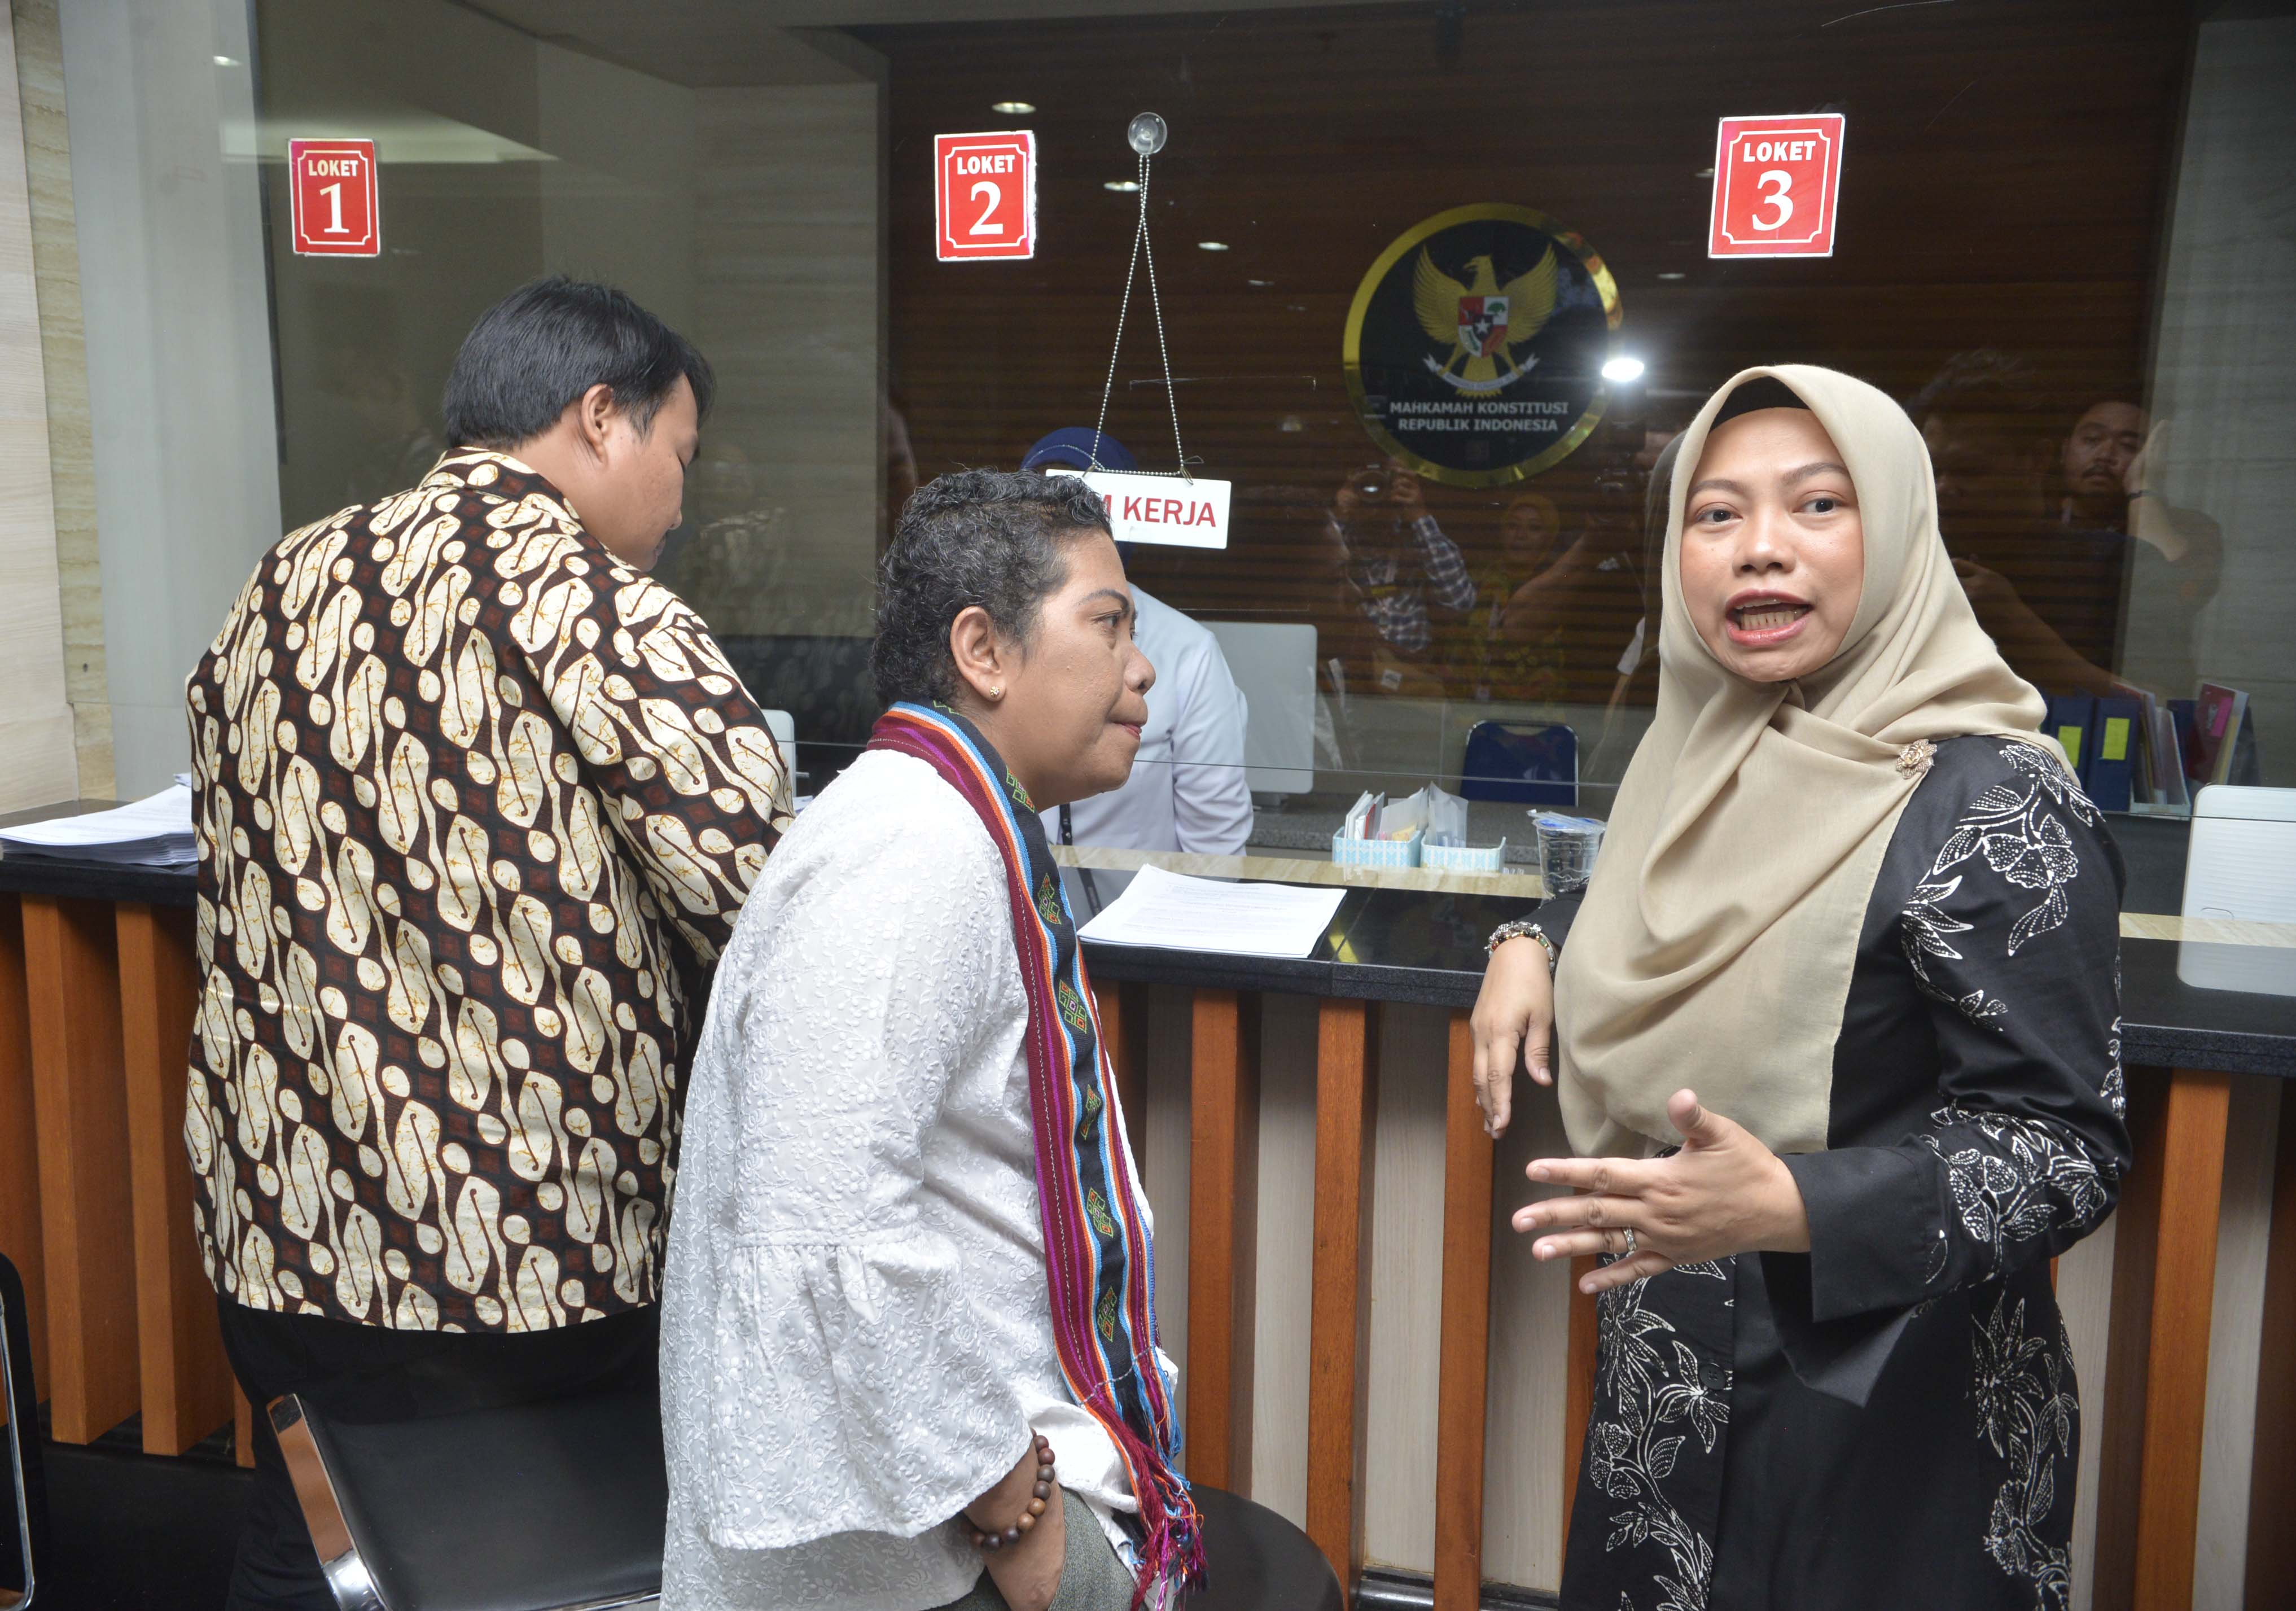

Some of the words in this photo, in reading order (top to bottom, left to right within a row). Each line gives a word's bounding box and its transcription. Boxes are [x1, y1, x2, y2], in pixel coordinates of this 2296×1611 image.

[1743, 141, 1816, 162] LOKET
[308, 159, 359, 177] LOKET
[957, 155, 1015, 175] LOKET
[319, 182, 350, 233] 1
[969, 181, 1004, 235] 2
[1751, 169, 1794, 231] 3
[1390, 401, 1474, 414] MAHKAMAH
[1478, 401, 1569, 414] KONSTITUSI
[1398, 418, 1470, 431] REPUBLIK
[1473, 418, 1558, 431] INDONESIA
[1123, 496, 1216, 528] KERJA
